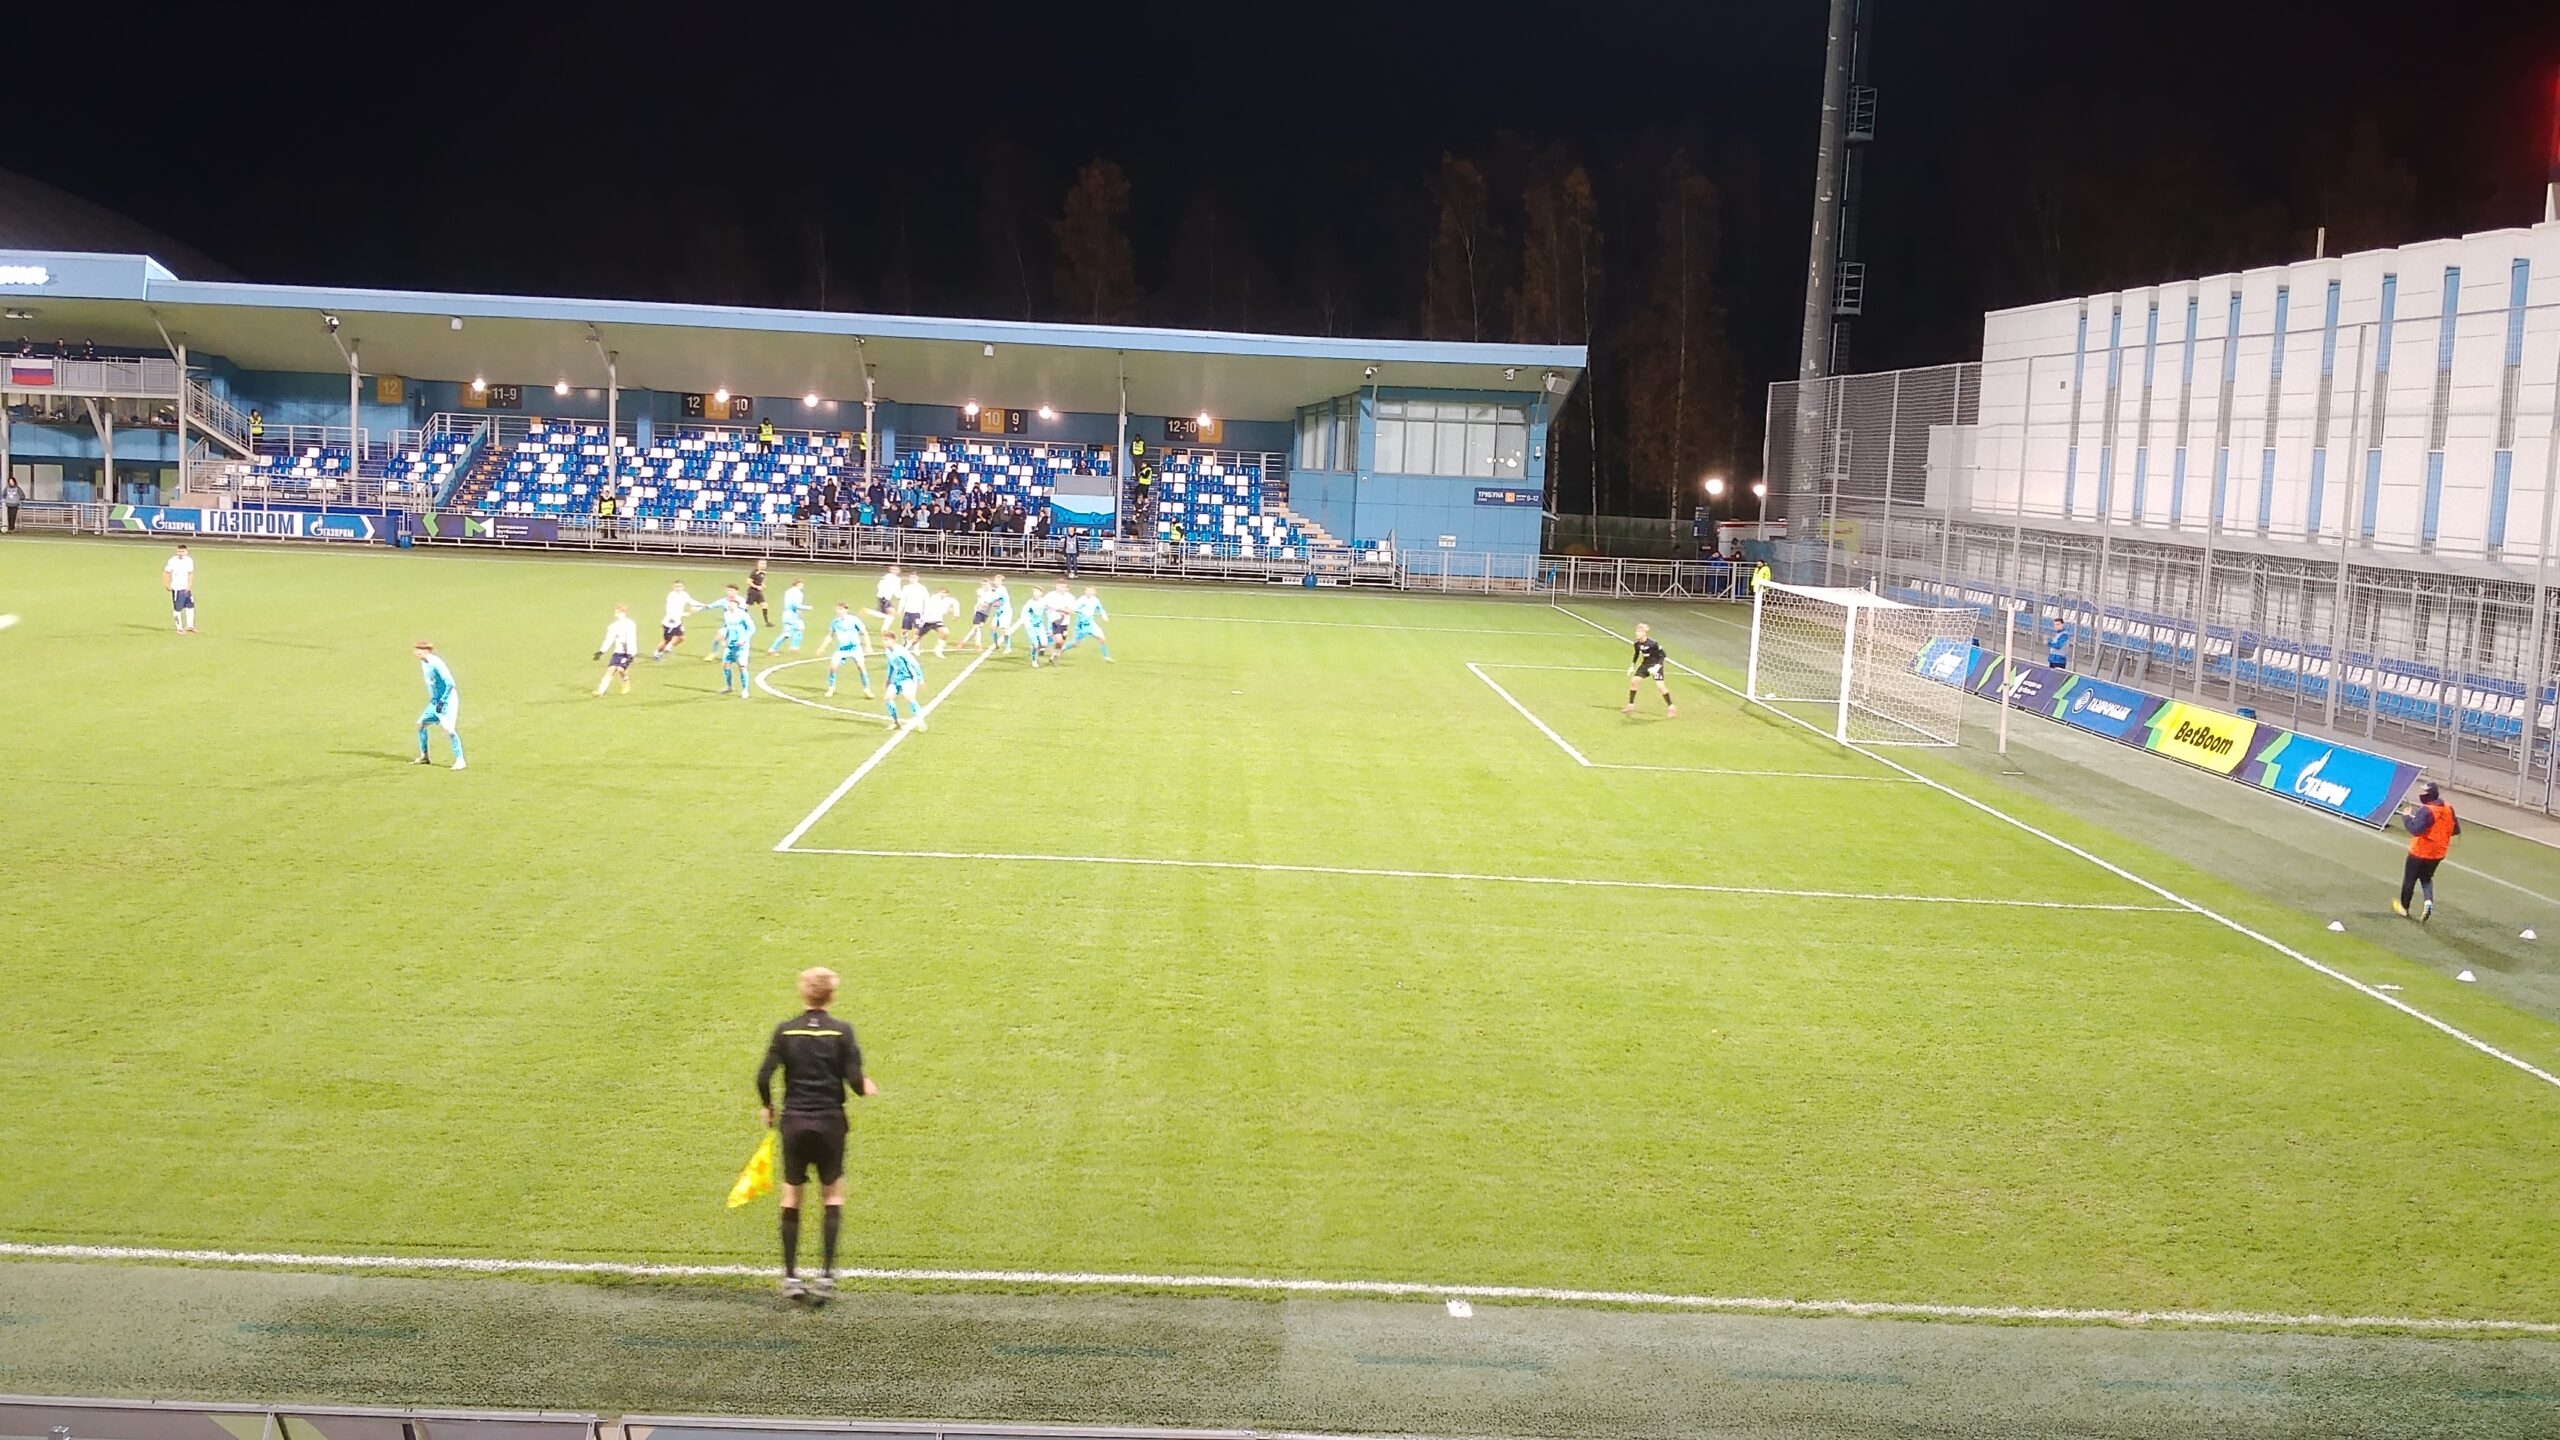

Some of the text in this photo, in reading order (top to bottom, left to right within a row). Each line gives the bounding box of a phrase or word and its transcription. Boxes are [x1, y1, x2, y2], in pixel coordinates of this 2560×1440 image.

[382, 381, 398, 395] 12
[492, 387, 517, 400] 11-9
[687, 396, 700, 408] 12
[735, 398, 749, 411] 10
[985, 411, 1000, 425] 10
[1012, 412, 1020, 425] 9
[1168, 420, 1197, 433] 12-10
[209, 511, 295, 534] ГАЗПРОМ
[2174, 721, 2233, 755] BetBoom
